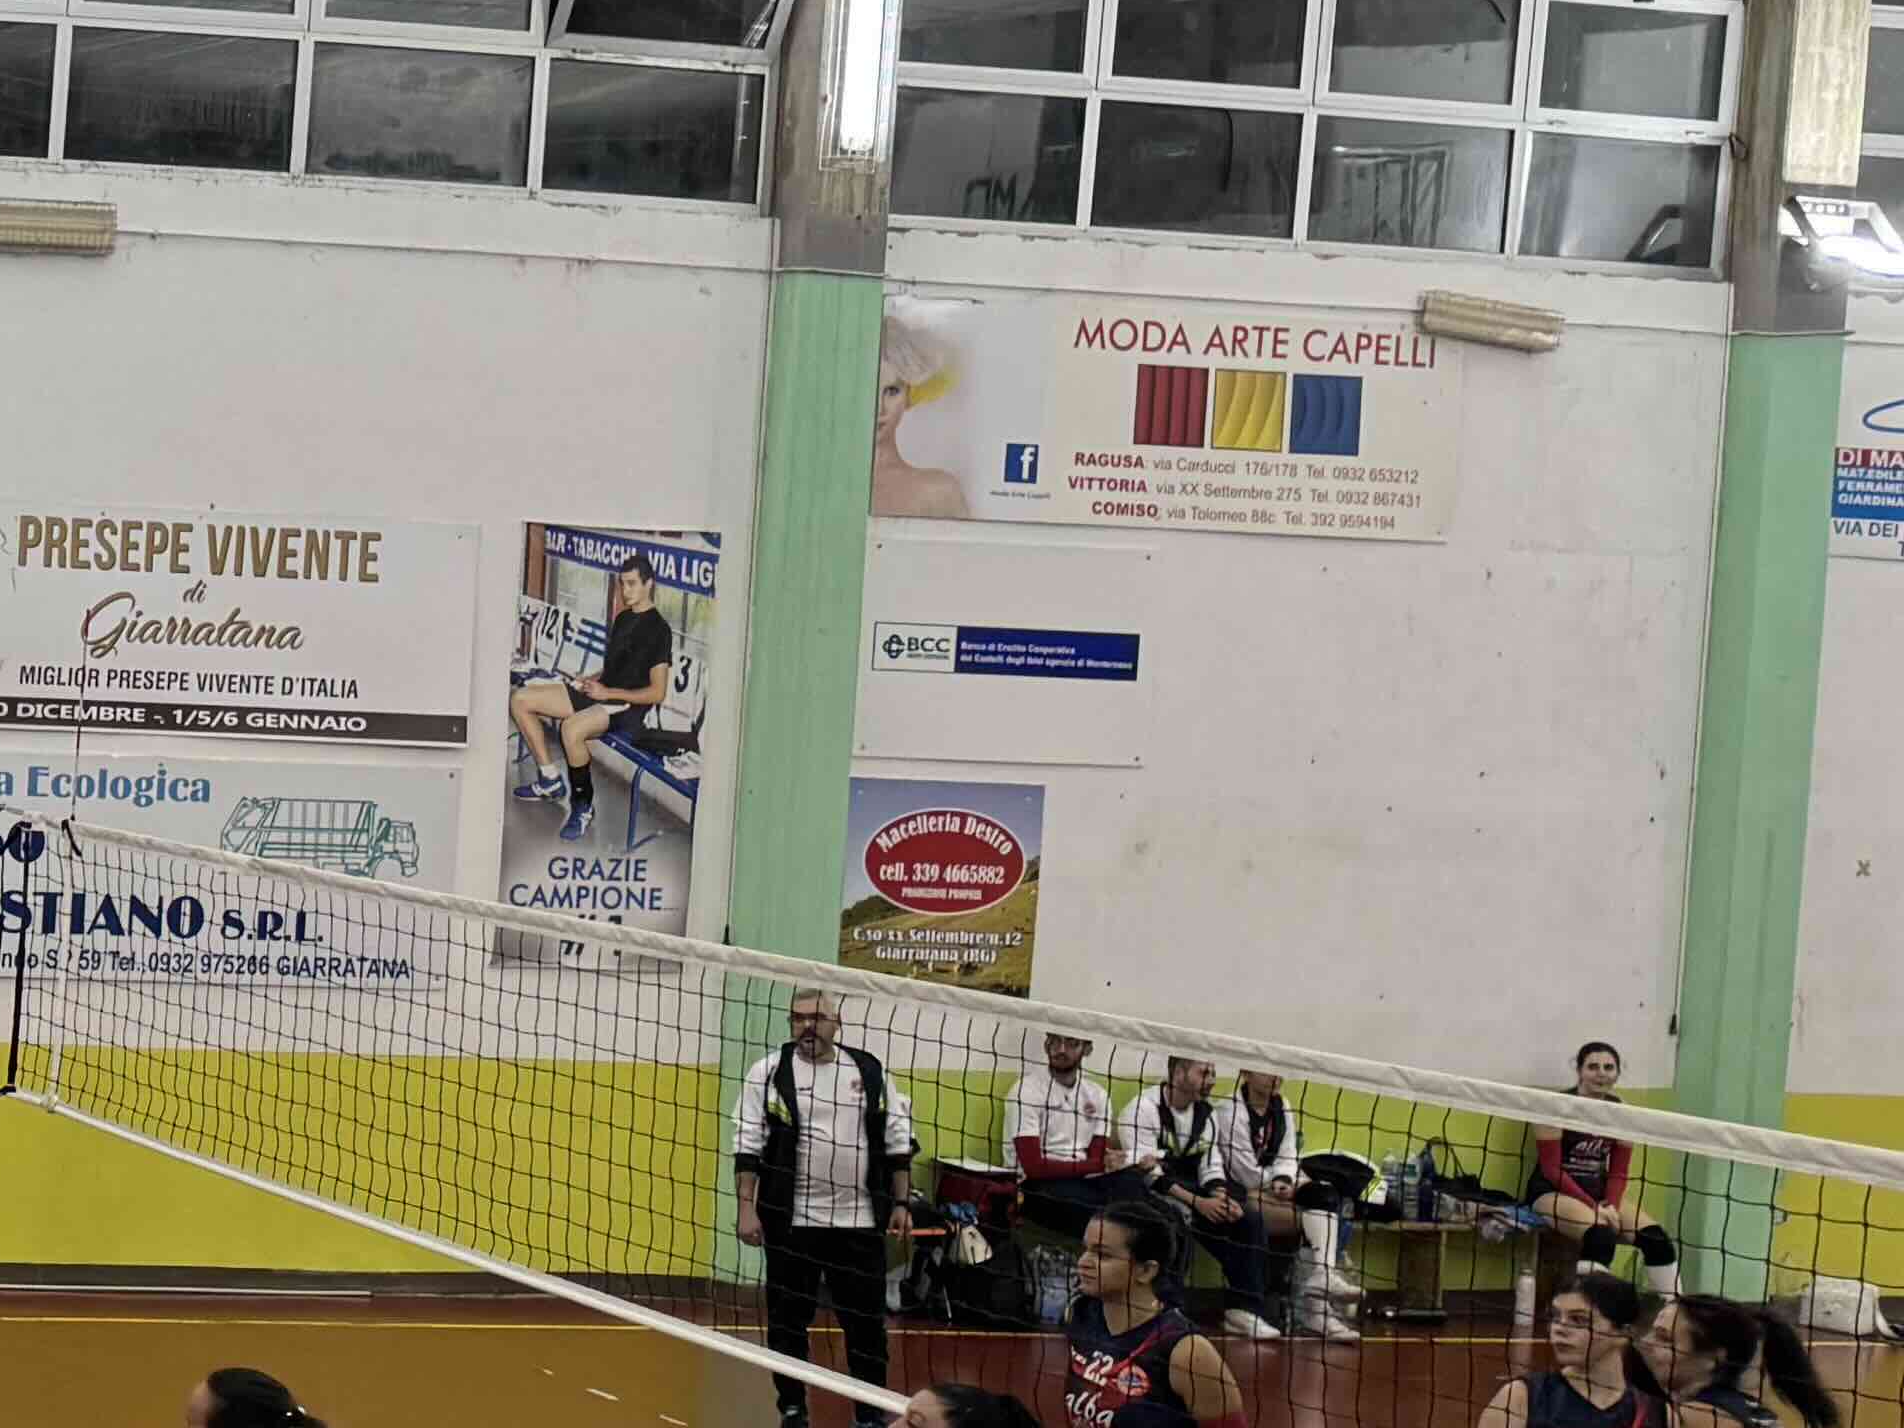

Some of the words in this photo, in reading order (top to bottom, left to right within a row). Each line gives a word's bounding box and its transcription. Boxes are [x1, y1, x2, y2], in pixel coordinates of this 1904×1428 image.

[1073, 317, 1193, 355] MODA
[1203, 324, 1291, 359] ARTE
[1303, 328, 1436, 369] CAPELLI
[1837, 448, 1863, 466] DI
[1332, 465, 1365, 481] 0932
[1179, 481, 1201, 497] XX
[1203, 483, 1273, 501] Settembre
[1277, 486, 1303, 503] 275
[1336, 490, 1371, 507] 0932
[1833, 519, 1864, 536] VIA
[16, 515, 193, 576] PRESEPE
[206, 523, 383, 584] VIVENTE
[647, 549, 677, 580] VIA
[182, 580, 207, 604] di
[81, 590, 306, 658] Giarratana
[906, 637, 951, 653] BCC
[19, 664, 100, 689] MIGLIOR
[106, 668, 190, 692] PRESEPE
[196, 672, 275, 695] VIVENTE
[280, 675, 359, 700] D'ITALIA
[674, 655, 692, 693] 3
[16, 702, 146, 724] DICEMBRE
[172, 708, 239, 728] 1/5/6
[245, 712, 368, 733] GENNAIO
[26, 765, 211, 808] Ecologica
[875, 812, 961, 853] Macelleria
[963, 815, 1013, 856] Destro
[547, 855, 648, 882] GRAZIE
[879, 861, 908, 882] cell.
[912, 862, 940, 883] 339
[942, 864, 1005, 885] 4665882
[509, 883, 664, 911] CAMPIONE
[220, 908, 324, 942] S.R.L.
[147, 952, 194, 973] 0932
[276, 954, 413, 980] GIARRATANA
